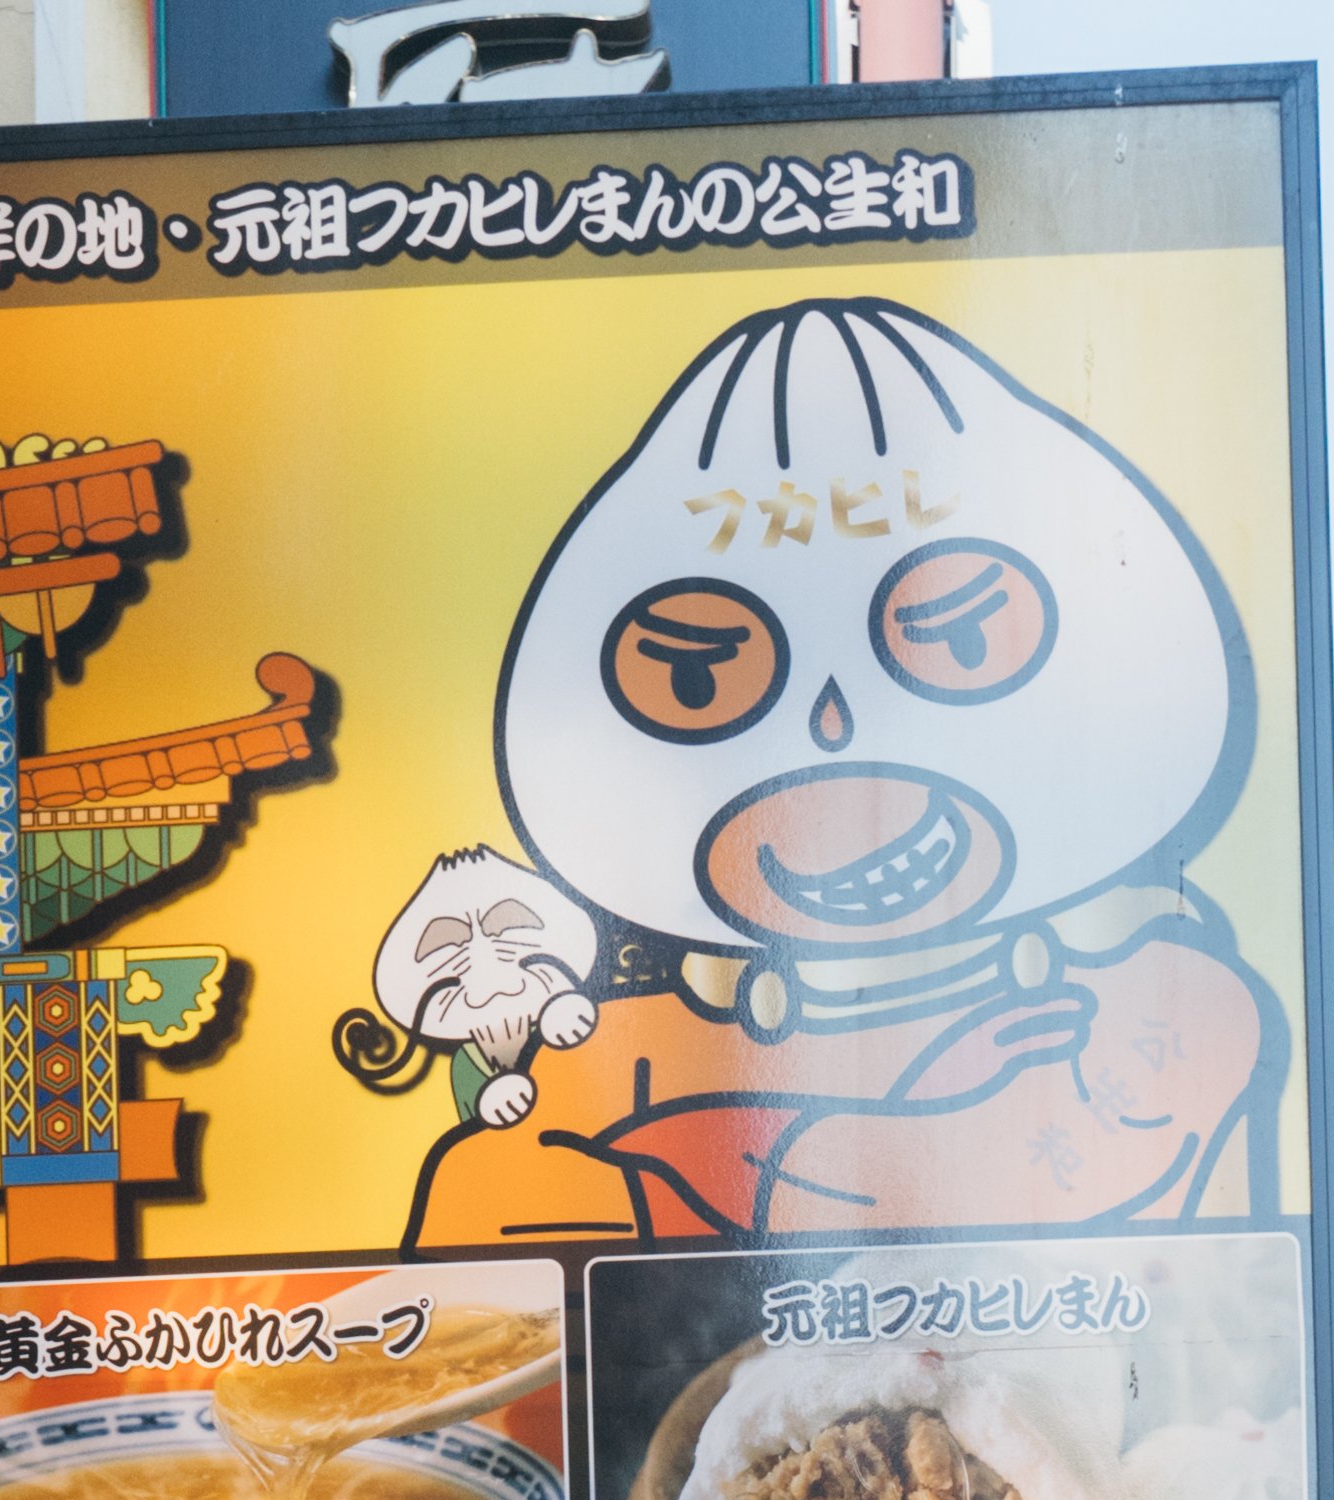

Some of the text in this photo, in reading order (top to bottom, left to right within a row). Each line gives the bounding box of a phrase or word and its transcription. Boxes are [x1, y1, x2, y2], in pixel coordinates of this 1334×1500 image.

[683, 472, 961, 556] フカヒレ
[763, 1274, 1151, 1348] 元祖フカヒレまん
